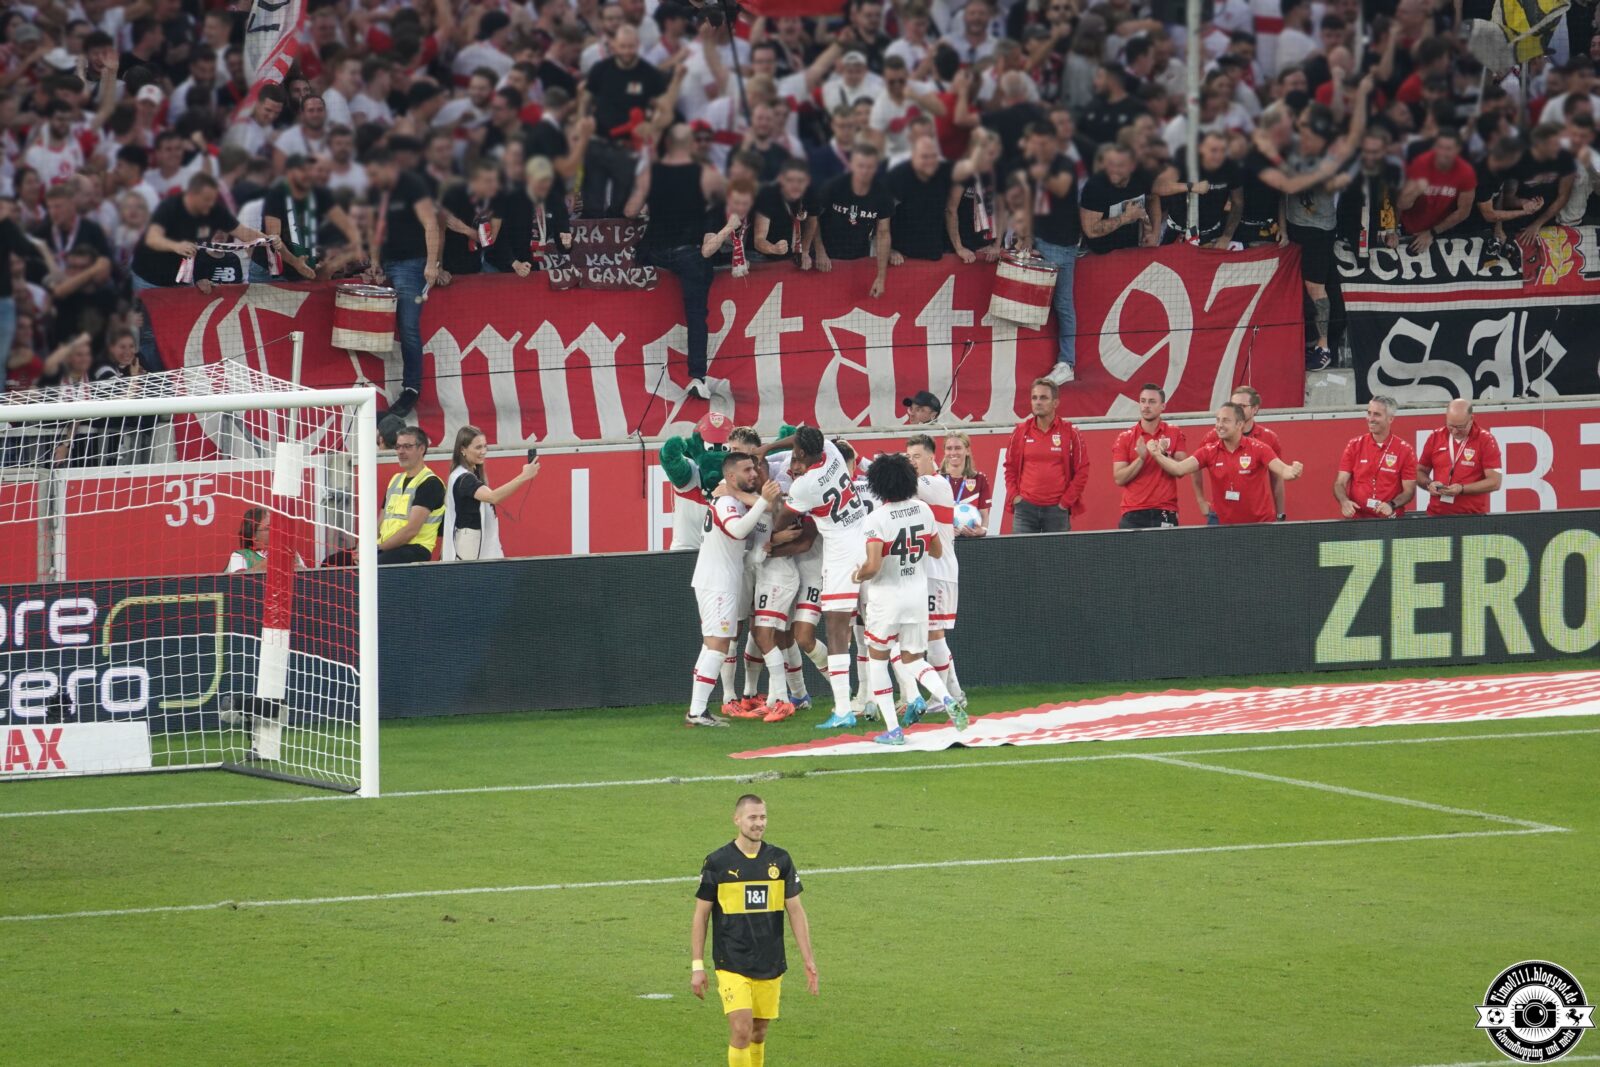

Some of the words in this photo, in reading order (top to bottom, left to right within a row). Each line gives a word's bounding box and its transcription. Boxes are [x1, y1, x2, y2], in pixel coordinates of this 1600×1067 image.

[585, 246, 635, 266] KAM
[588, 265, 657, 288] GANZE
[1333, 236, 1522, 281] SCHWA
[1099, 257, 1279, 418] 97
[818, 458, 841, 487] STUTTGART
[165, 479, 215, 527] 35
[822, 472, 861, 524] 23
[890, 505, 921, 520] STUTTGART
[890, 524, 925, 566] 45
[758, 594, 768, 609] 8
[806, 586, 819, 603] 18
[1315, 529, 1600, 664] ZERO
[0, 597, 98, 646] re
[0, 666, 149, 718] ero
[0, 728, 67, 771] AX
[746, 890, 766, 904] 1&1
